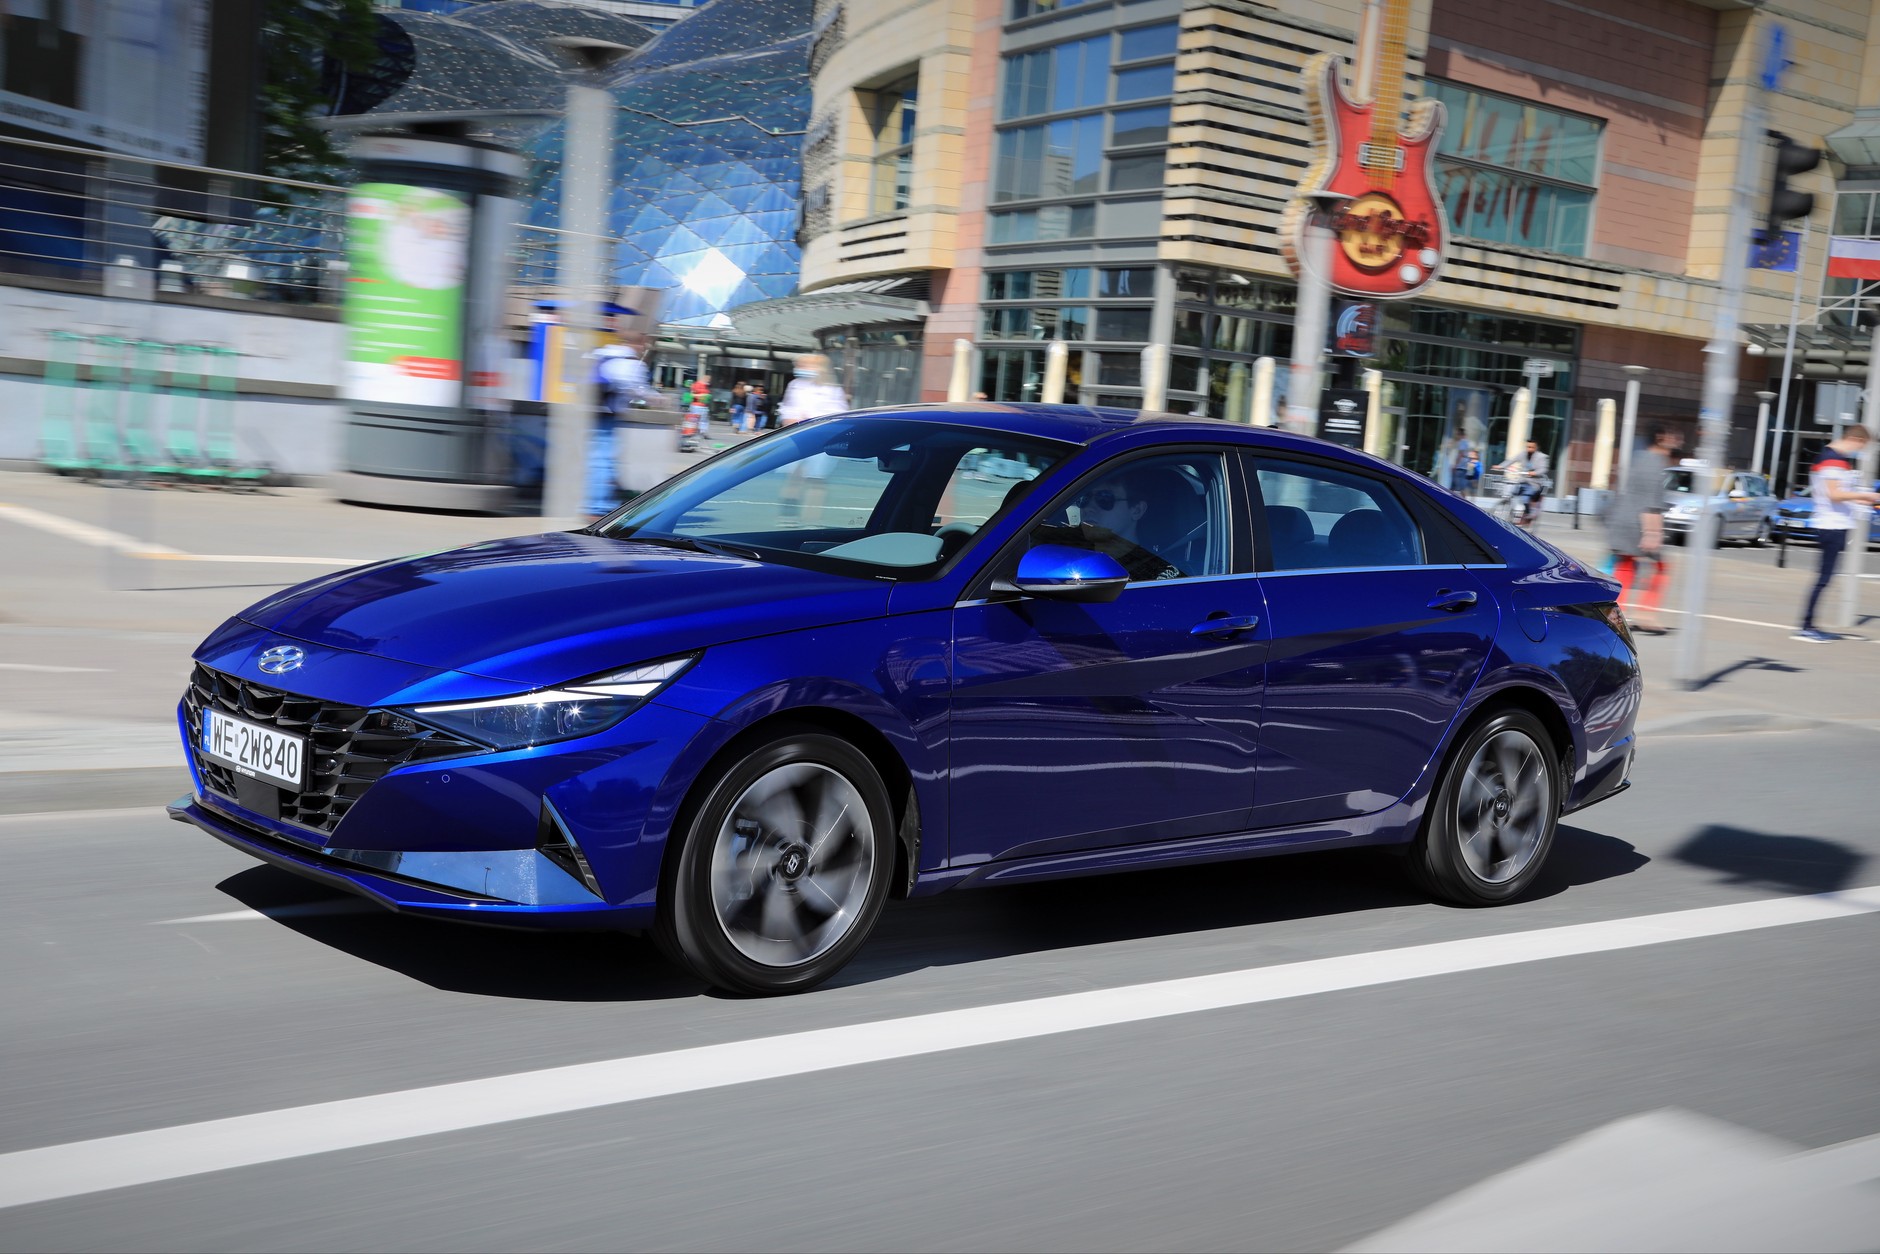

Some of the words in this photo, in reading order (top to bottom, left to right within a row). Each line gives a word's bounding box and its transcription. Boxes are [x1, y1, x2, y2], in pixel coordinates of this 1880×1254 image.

[204, 735, 210, 746] PL
[214, 717, 233, 757] WE
[240, 727, 297, 778] 2W840
